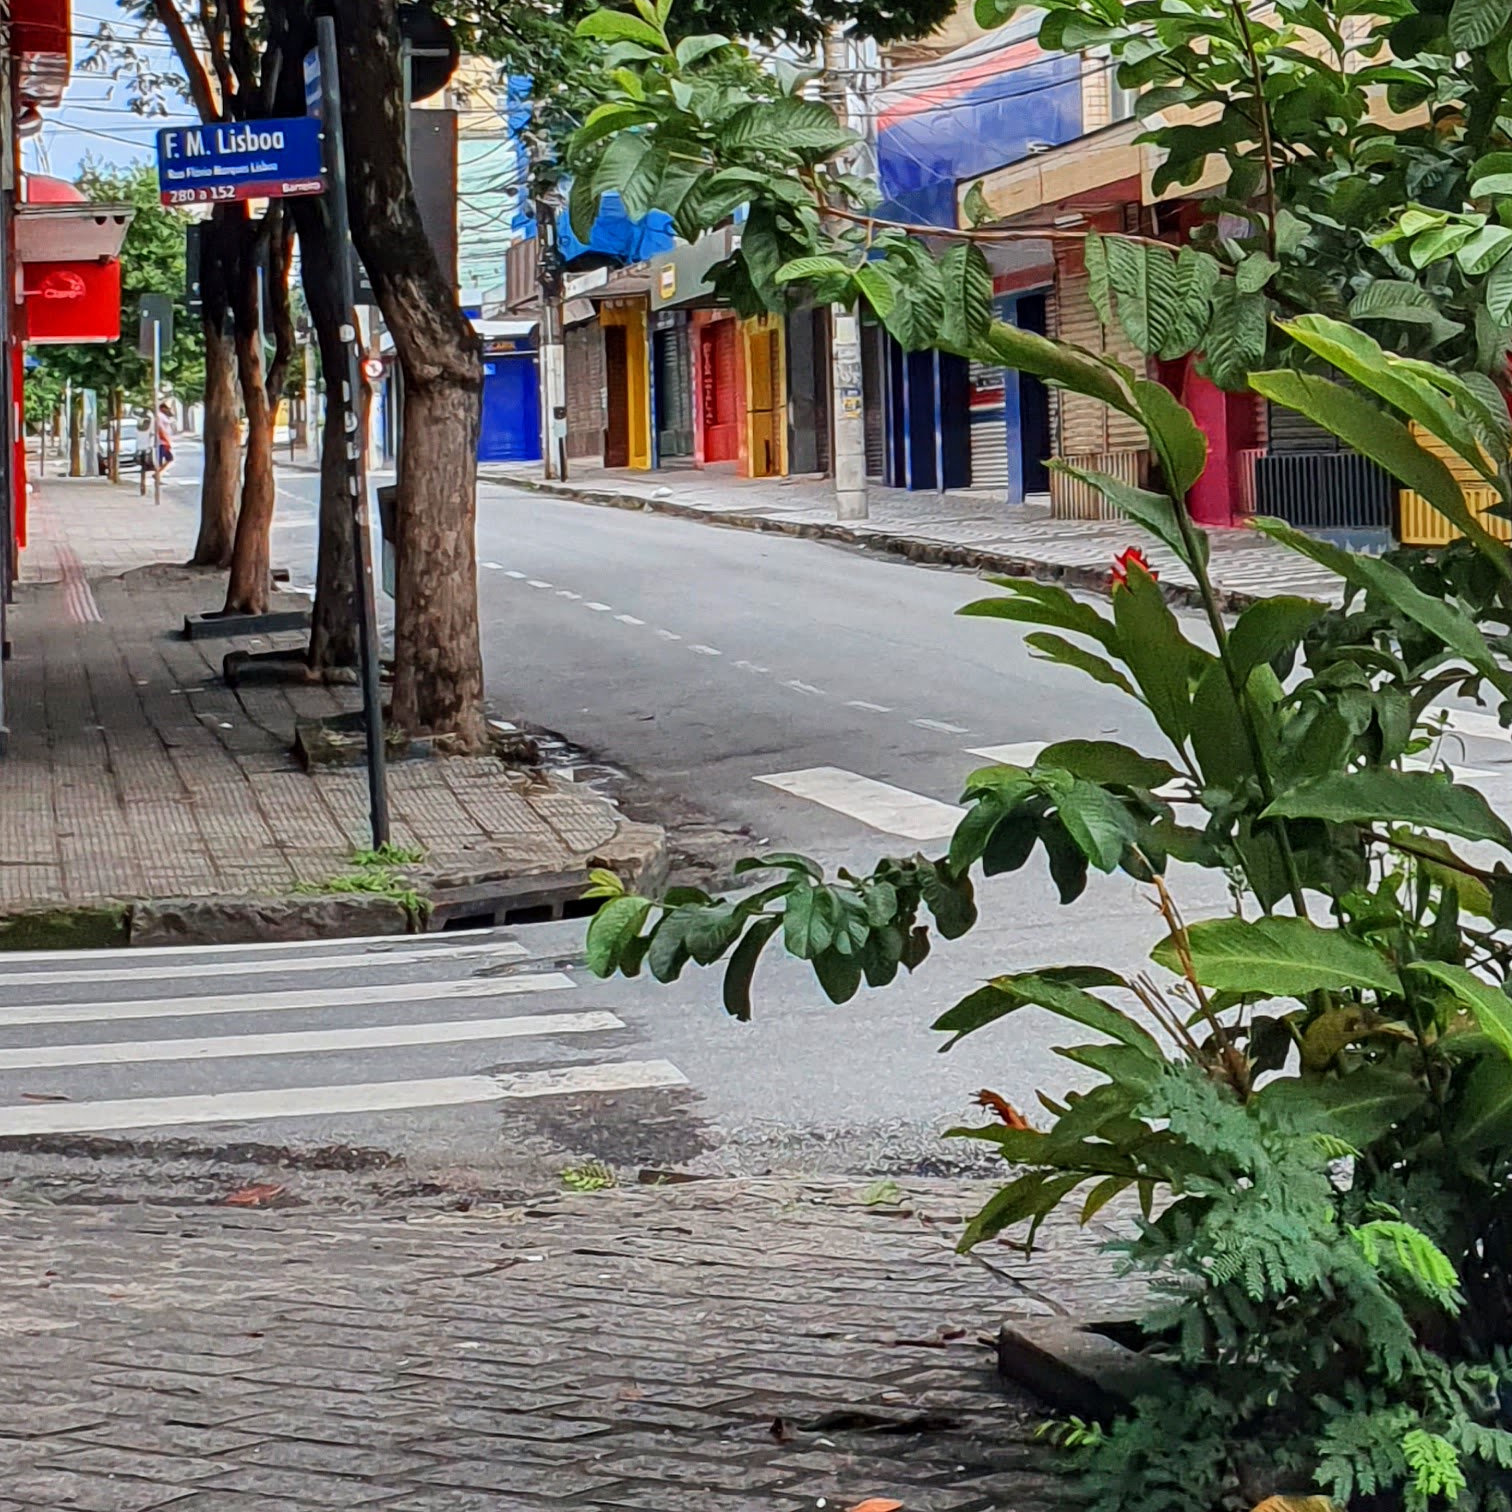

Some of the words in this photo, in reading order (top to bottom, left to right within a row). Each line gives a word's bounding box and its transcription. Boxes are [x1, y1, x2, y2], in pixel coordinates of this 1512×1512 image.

[165, 133, 180, 159] F.
[187, 130, 211, 157] M.
[217, 125, 285, 155] Lisboa
[170, 189, 195, 203] 280
[199, 189, 207, 199] a
[210, 185, 235, 199] 152
